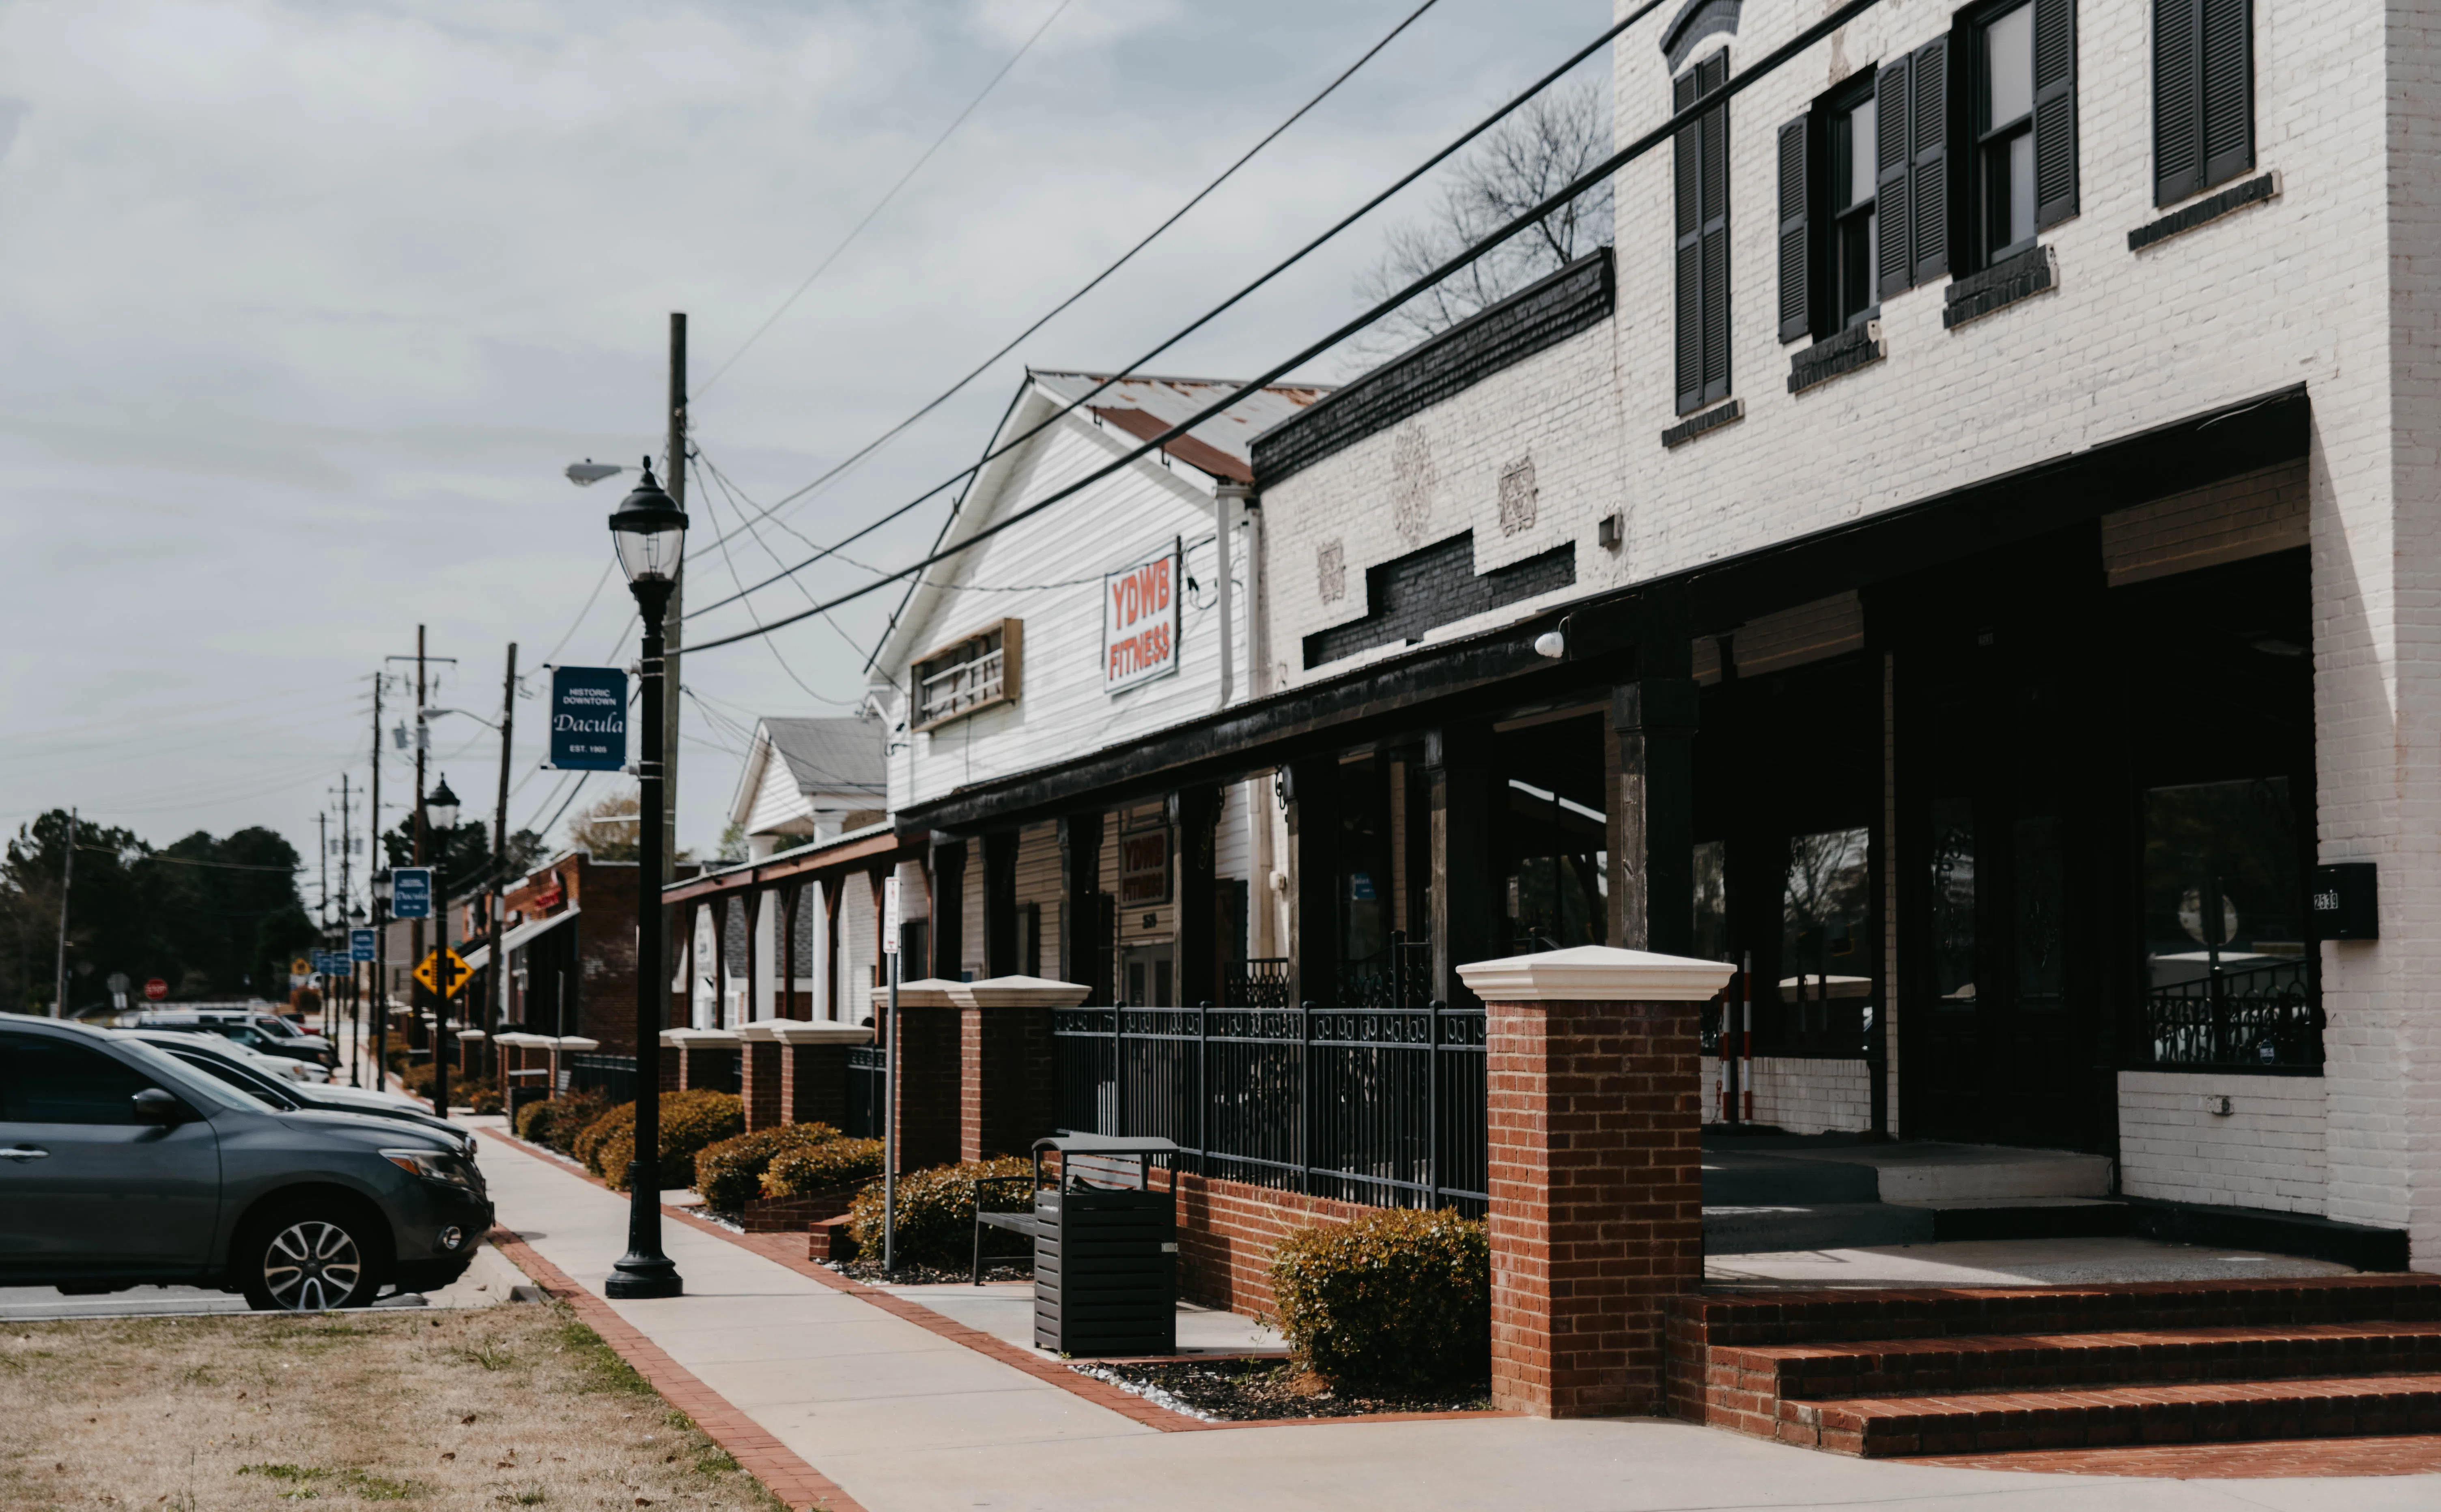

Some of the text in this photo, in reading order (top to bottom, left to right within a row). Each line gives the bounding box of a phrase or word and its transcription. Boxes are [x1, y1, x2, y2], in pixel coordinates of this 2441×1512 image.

[1113, 557, 1169, 630] YDWB
[1110, 622, 1169, 681] FITNESS
[563, 696, 617, 705] DOWNTOWN
[569, 688, 610, 697] HISTORIC
[553, 712, 624, 733] Dacula
[569, 744, 588, 753] EST.
[1124, 834, 1164, 872] YDWB
[2314, 894, 2337, 909] 2539
